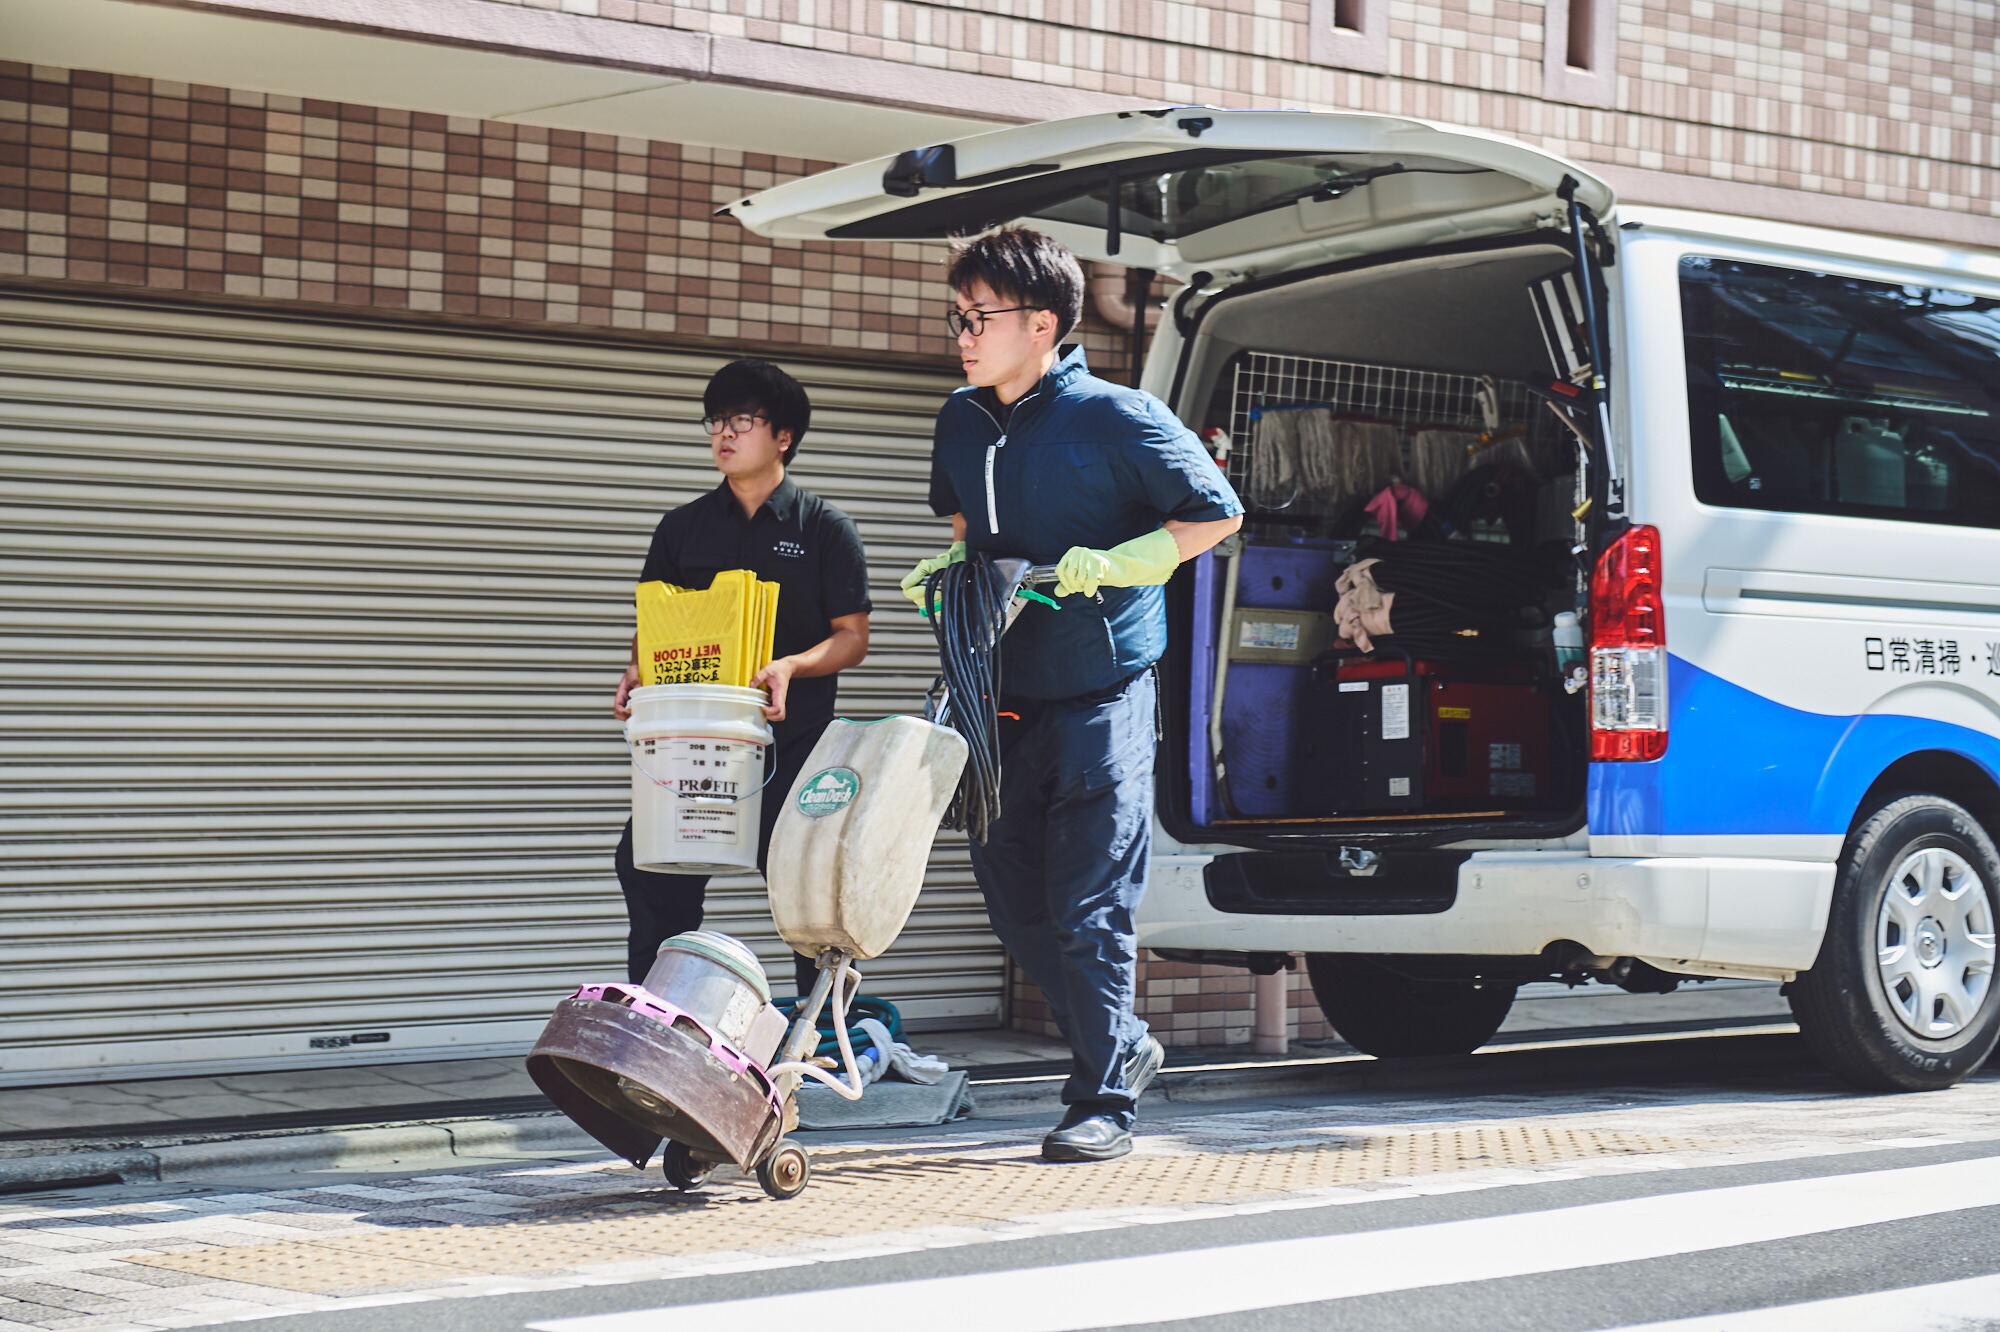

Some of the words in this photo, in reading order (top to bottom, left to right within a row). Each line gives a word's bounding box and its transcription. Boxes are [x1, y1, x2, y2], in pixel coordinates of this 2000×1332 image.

[653, 647, 692, 662] FLOOR
[695, 644, 721, 658] WET
[654, 656, 721, 674] ご注意ください
[800, 788, 827, 804] Clean
[827, 786, 852, 803] Dash
